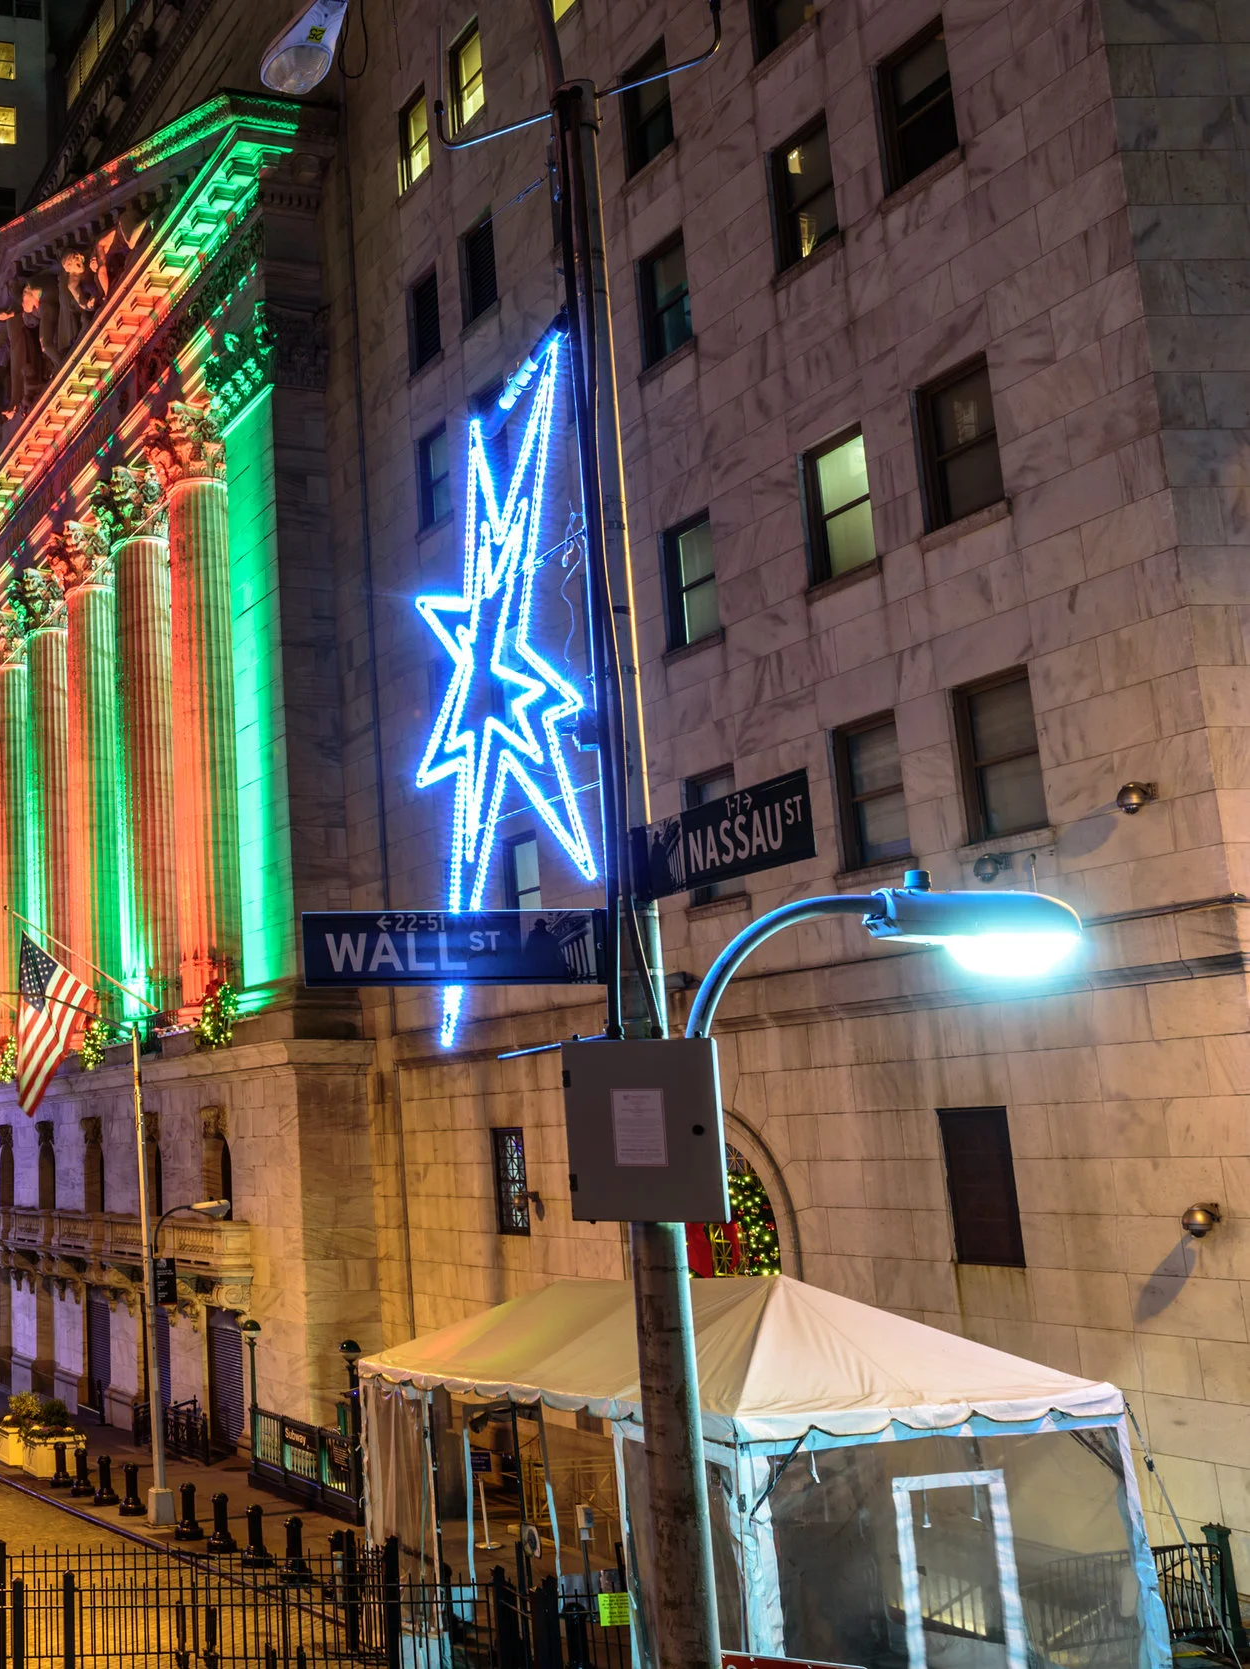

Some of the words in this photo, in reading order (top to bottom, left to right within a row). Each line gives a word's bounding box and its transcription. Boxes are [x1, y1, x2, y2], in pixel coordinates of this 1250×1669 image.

[725, 794, 740, 817] 1-7
[688, 802, 783, 874] NASSAU
[784, 794, 802, 825] ST
[395, 914, 446, 932] 22-51
[325, 931, 468, 972] WALL
[469, 930, 500, 951] ST
[285, 1426, 306, 1446] Subway
